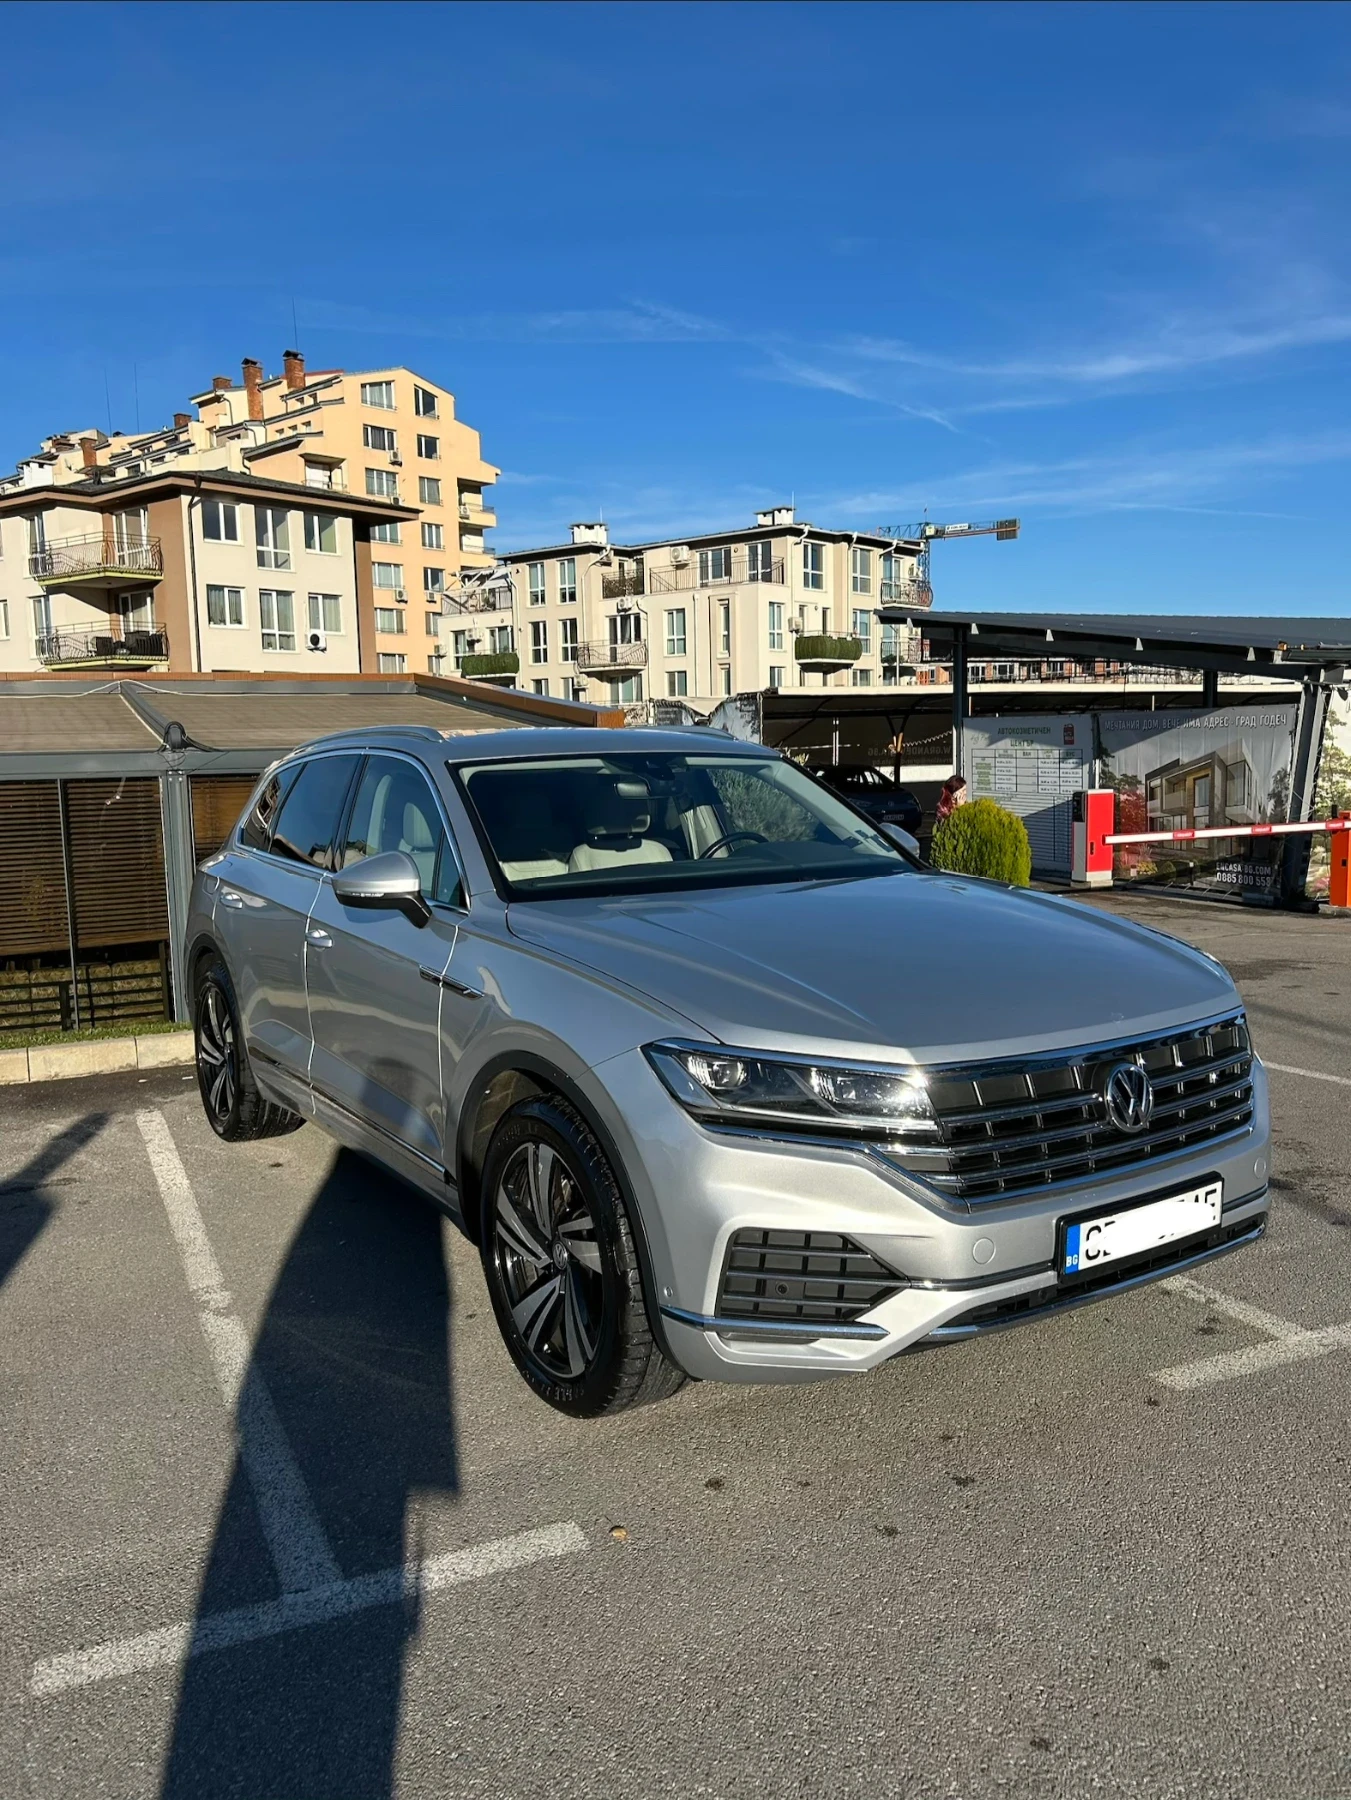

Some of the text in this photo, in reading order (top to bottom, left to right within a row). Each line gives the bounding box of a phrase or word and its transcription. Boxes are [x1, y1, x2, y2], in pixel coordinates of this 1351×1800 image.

[1105, 719, 1139, 730] МЕЧТАНИЯ
[1163, 718, 1180, 729] ВЕЧЕ
[1184, 717, 1200, 728] ИМА
[1203, 717, 1229, 729] АДРЕС
[1235, 716, 1256, 728] ГРАД
[1260, 714, 1286, 727] ГОДЕЧ
[998, 727, 1051, 735] АВТОКОЗМЕТИЧЕН
[1010, 739, 1034, 747] ЦЕНТЪР
[1216, 872, 1237, 884] 0885
[1238, 875, 1254, 885] 800
[1066, 1254, 1078, 1267] BG
